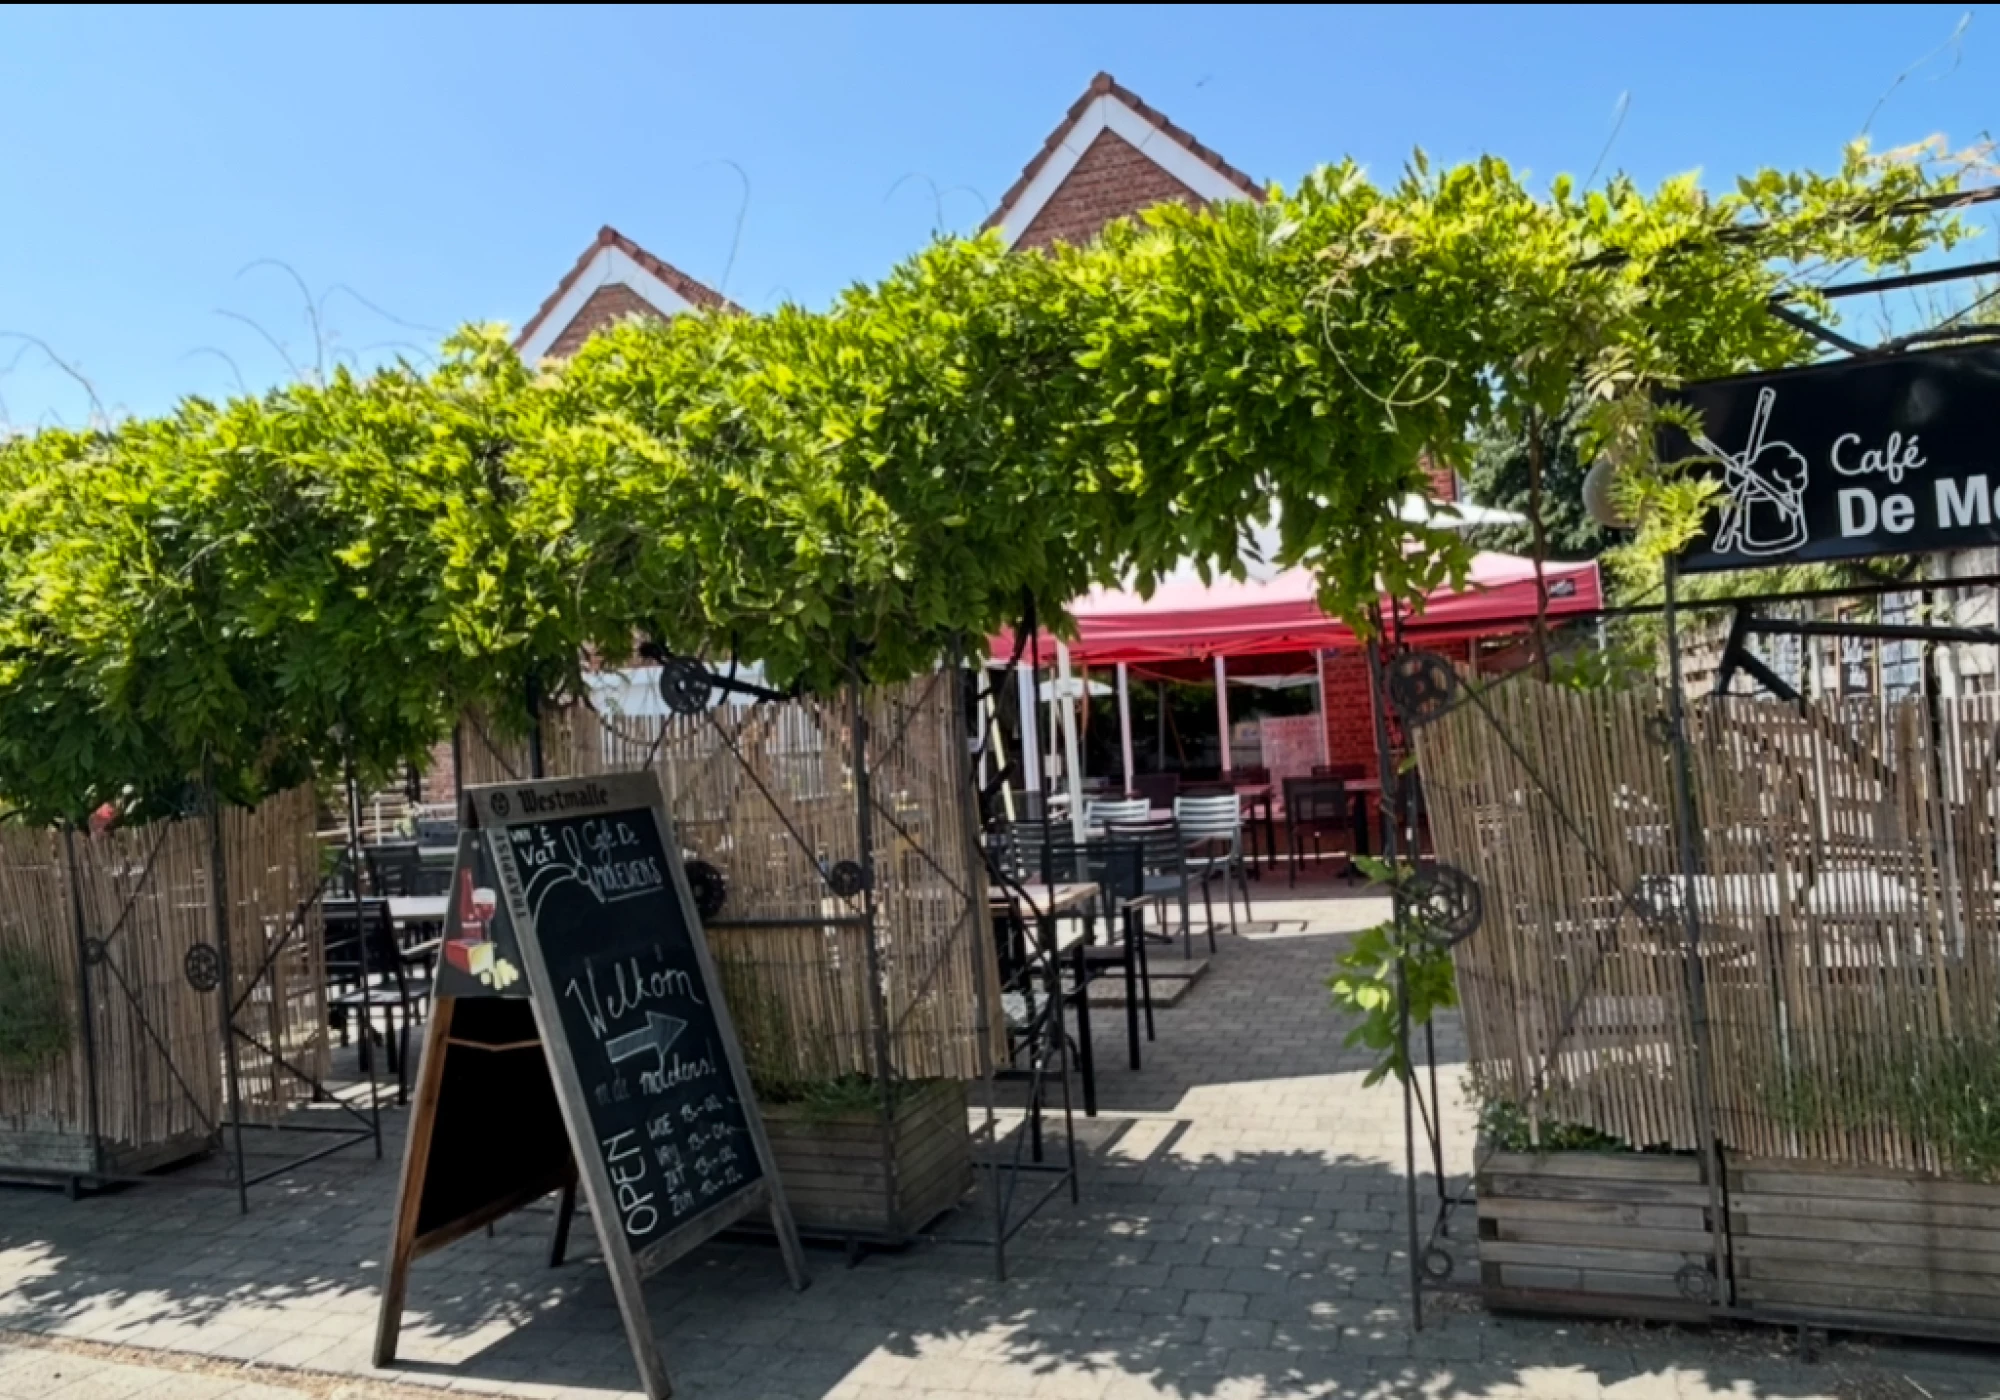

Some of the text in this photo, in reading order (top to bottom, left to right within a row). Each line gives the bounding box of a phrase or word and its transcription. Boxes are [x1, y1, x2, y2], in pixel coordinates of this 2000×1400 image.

[1830, 431, 1928, 485] Café
[1838, 474, 2000, 538] De M
[516, 783, 609, 814] Westmalle
[565, 955, 704, 1040] Welkom
[601, 1128, 659, 1236] OPEN
